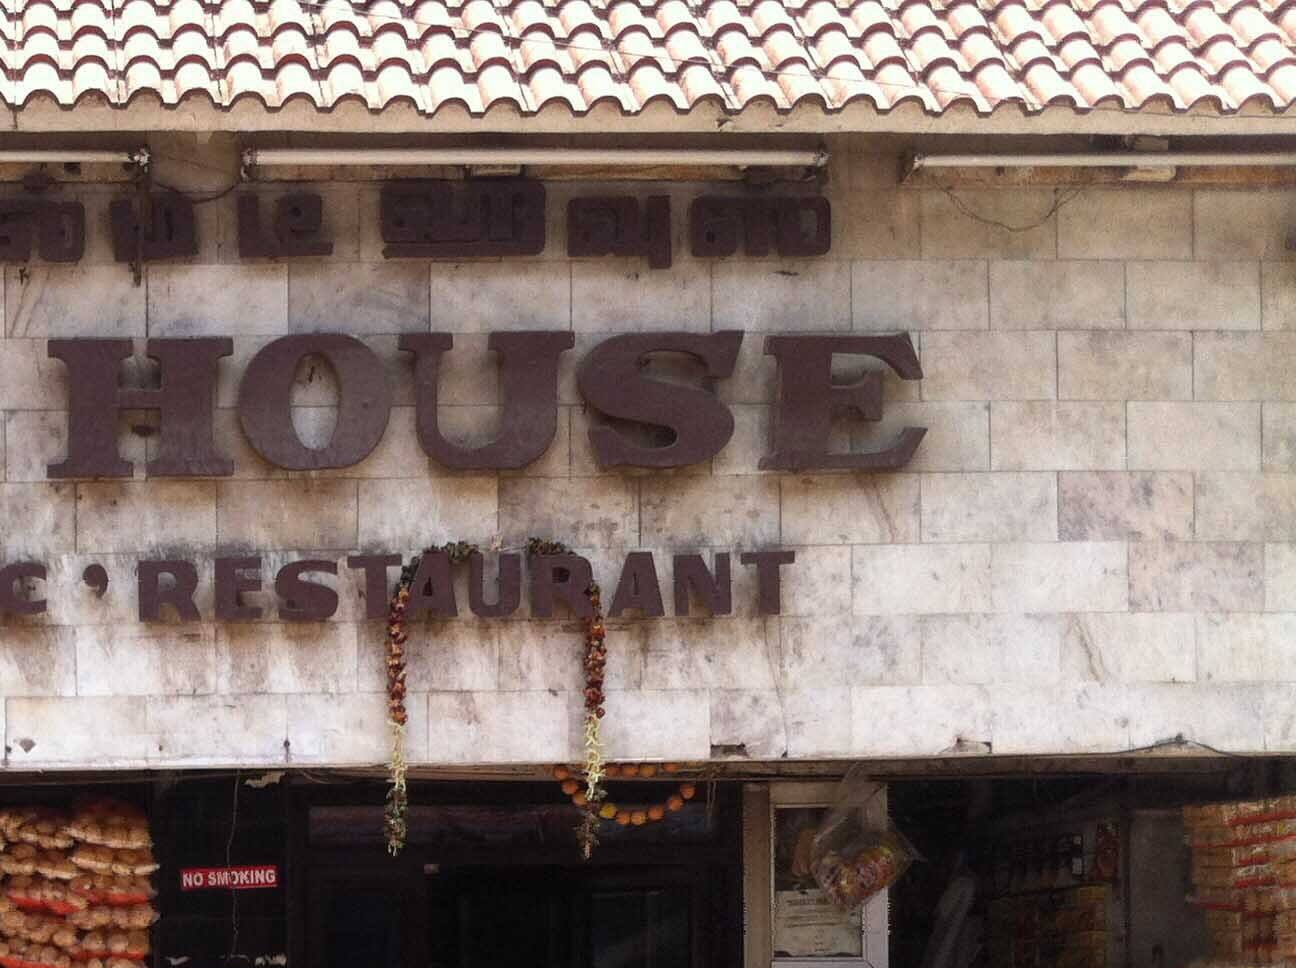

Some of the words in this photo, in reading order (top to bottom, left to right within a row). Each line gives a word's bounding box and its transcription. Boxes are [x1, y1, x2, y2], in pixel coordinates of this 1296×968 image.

[46, 331, 929, 479] HOUSE
[136, 550, 797, 623] RESTAURANT
[182, 871, 204, 887] NO
[207, 868, 277, 887] SMOKING
